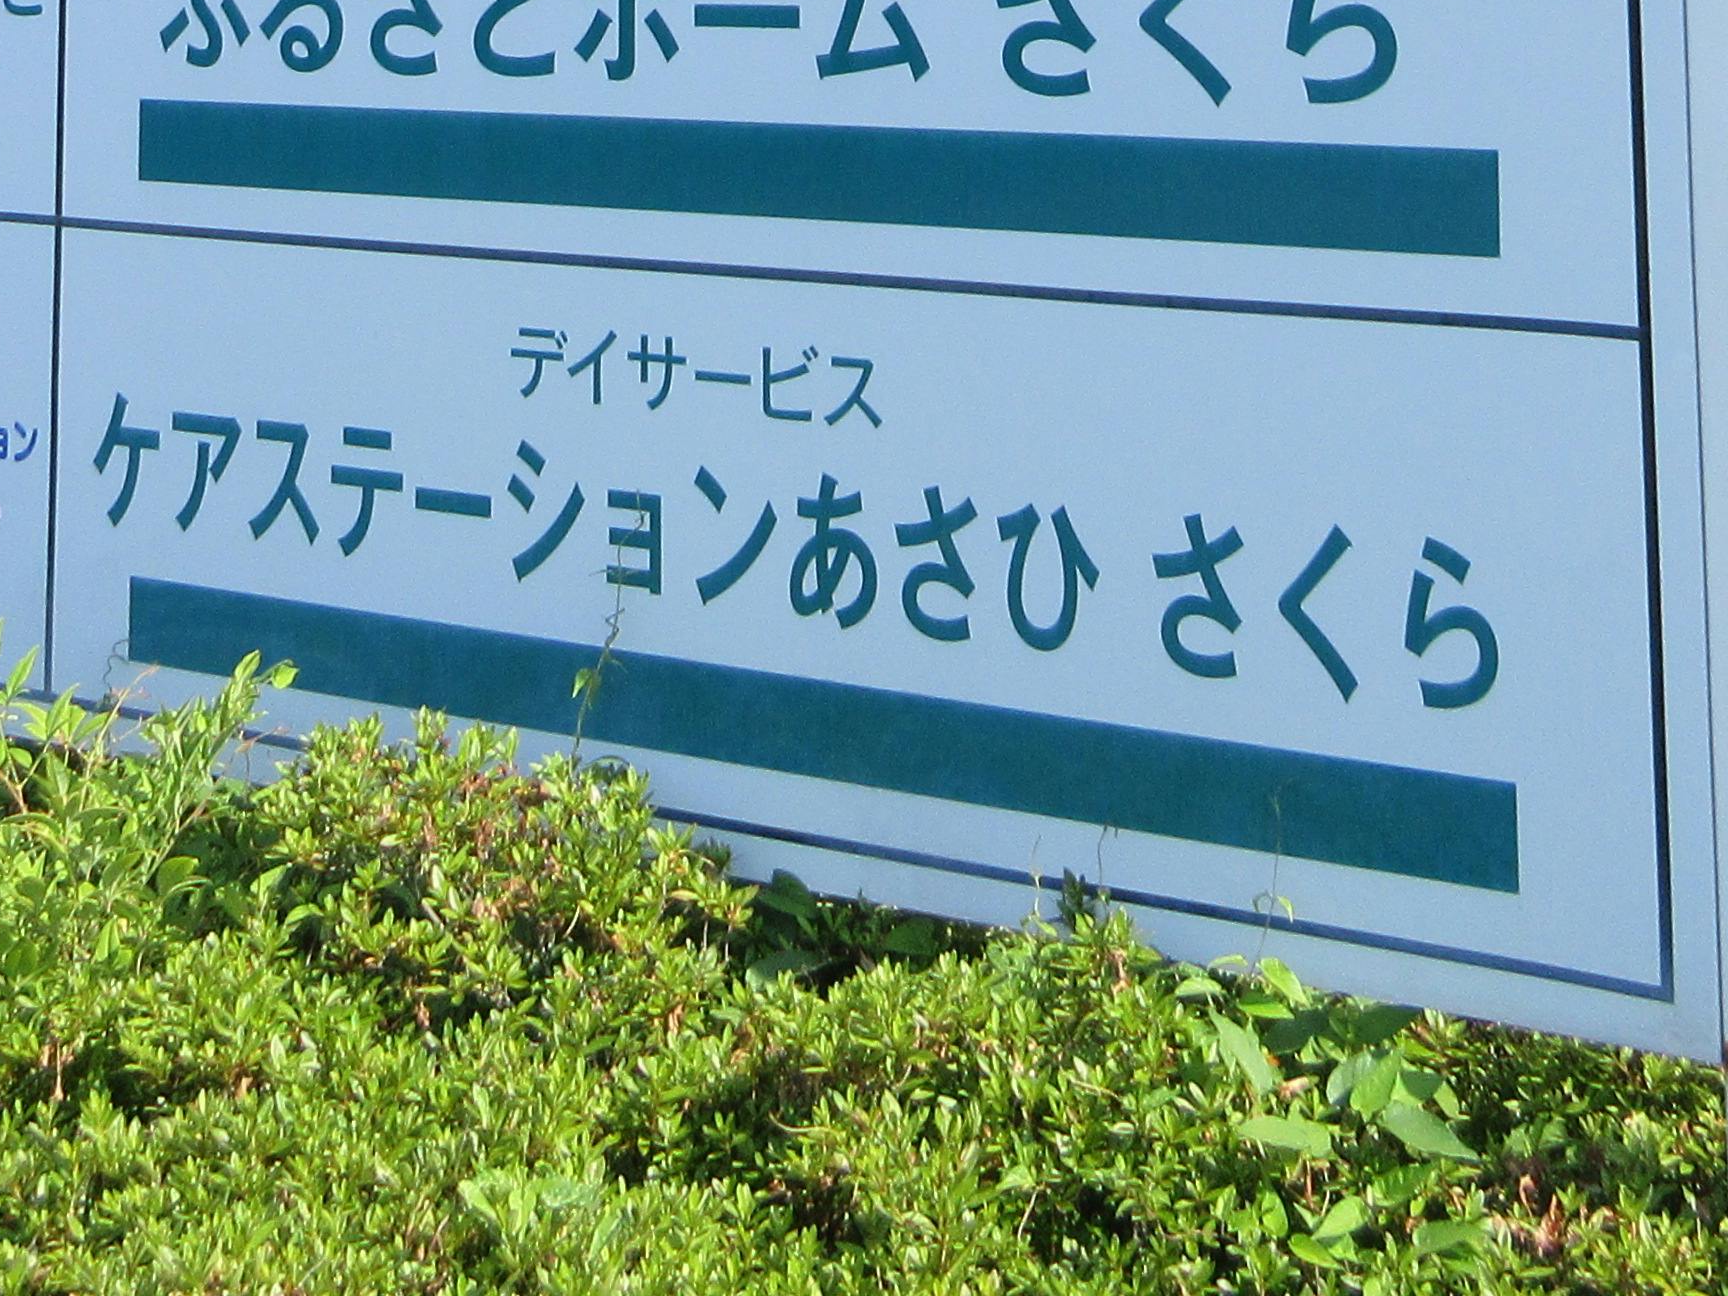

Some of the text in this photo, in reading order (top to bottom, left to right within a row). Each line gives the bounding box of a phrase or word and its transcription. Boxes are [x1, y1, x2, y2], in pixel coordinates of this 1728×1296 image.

[509, 326, 884, 430] デイサービス
[91, 390, 1500, 711] ケアステーションあさひ さくら
